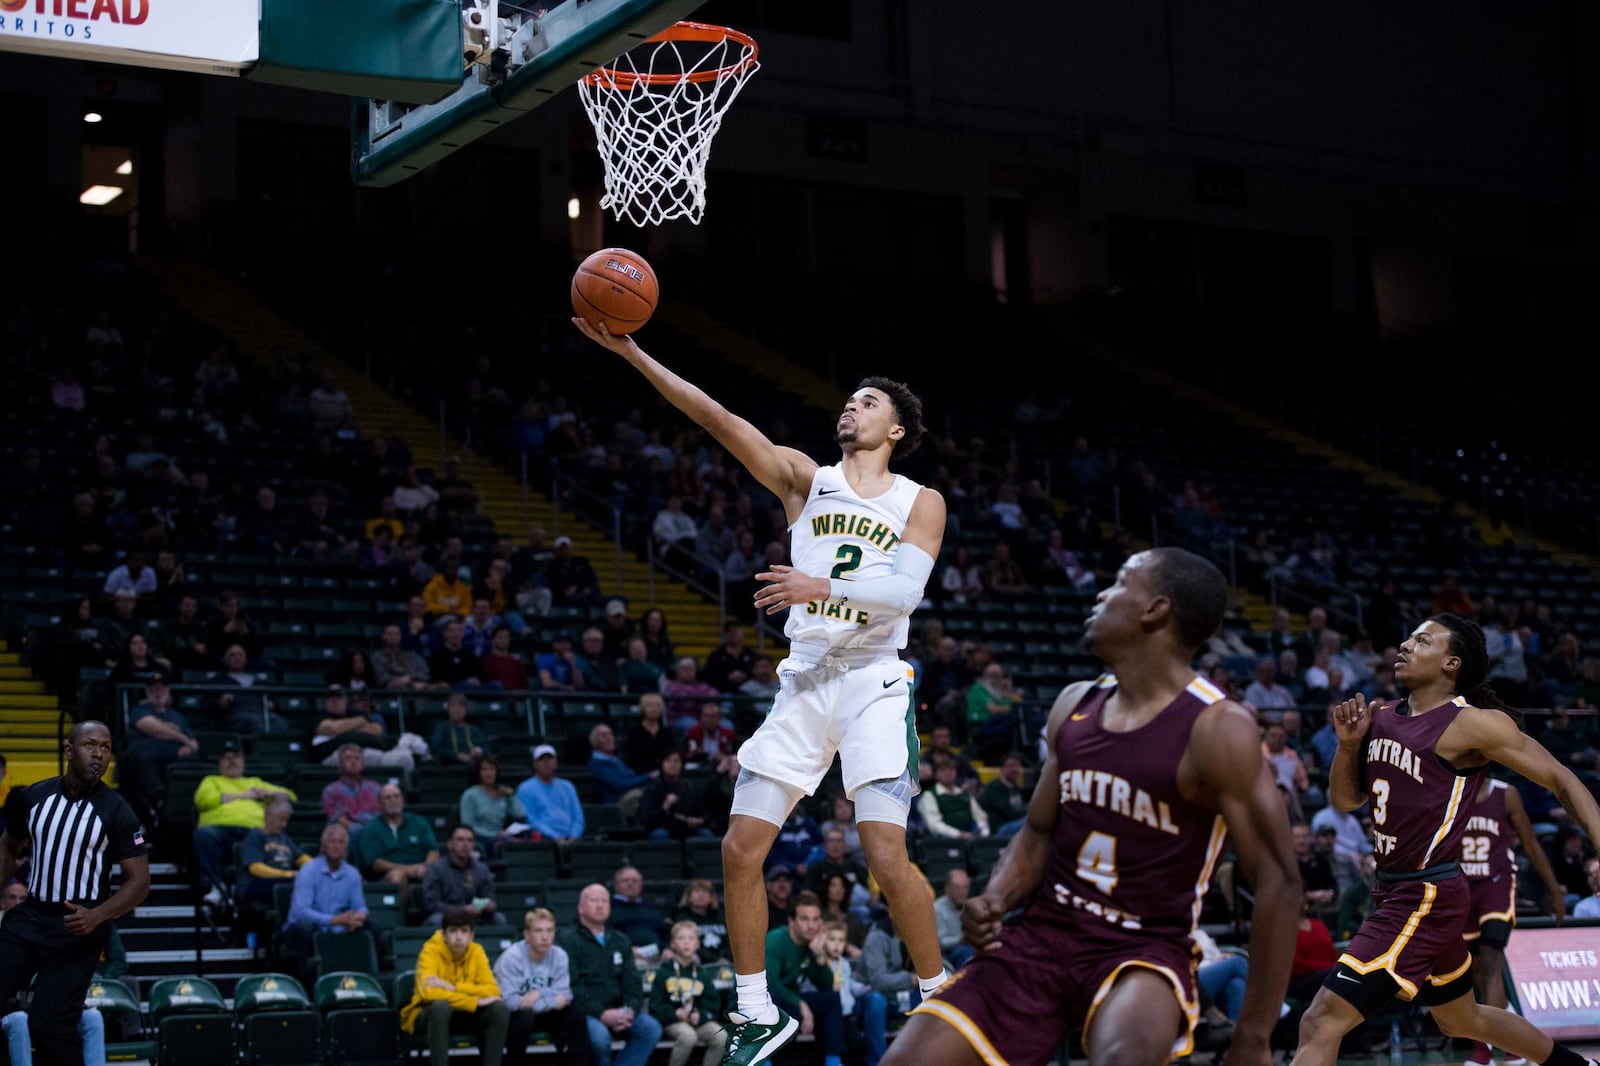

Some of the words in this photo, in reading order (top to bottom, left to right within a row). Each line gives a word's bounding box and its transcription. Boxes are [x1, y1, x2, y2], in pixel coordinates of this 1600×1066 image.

[605, 259, 643, 284] ELITE
[811, 513, 900, 552] WRIGHT
[830, 544, 863, 582] 2
[1372, 778, 1391, 826] 3
[1076, 831, 1119, 896] 4
[1461, 836, 1490, 861] 22
[1539, 950, 1597, 968] TICKETS
